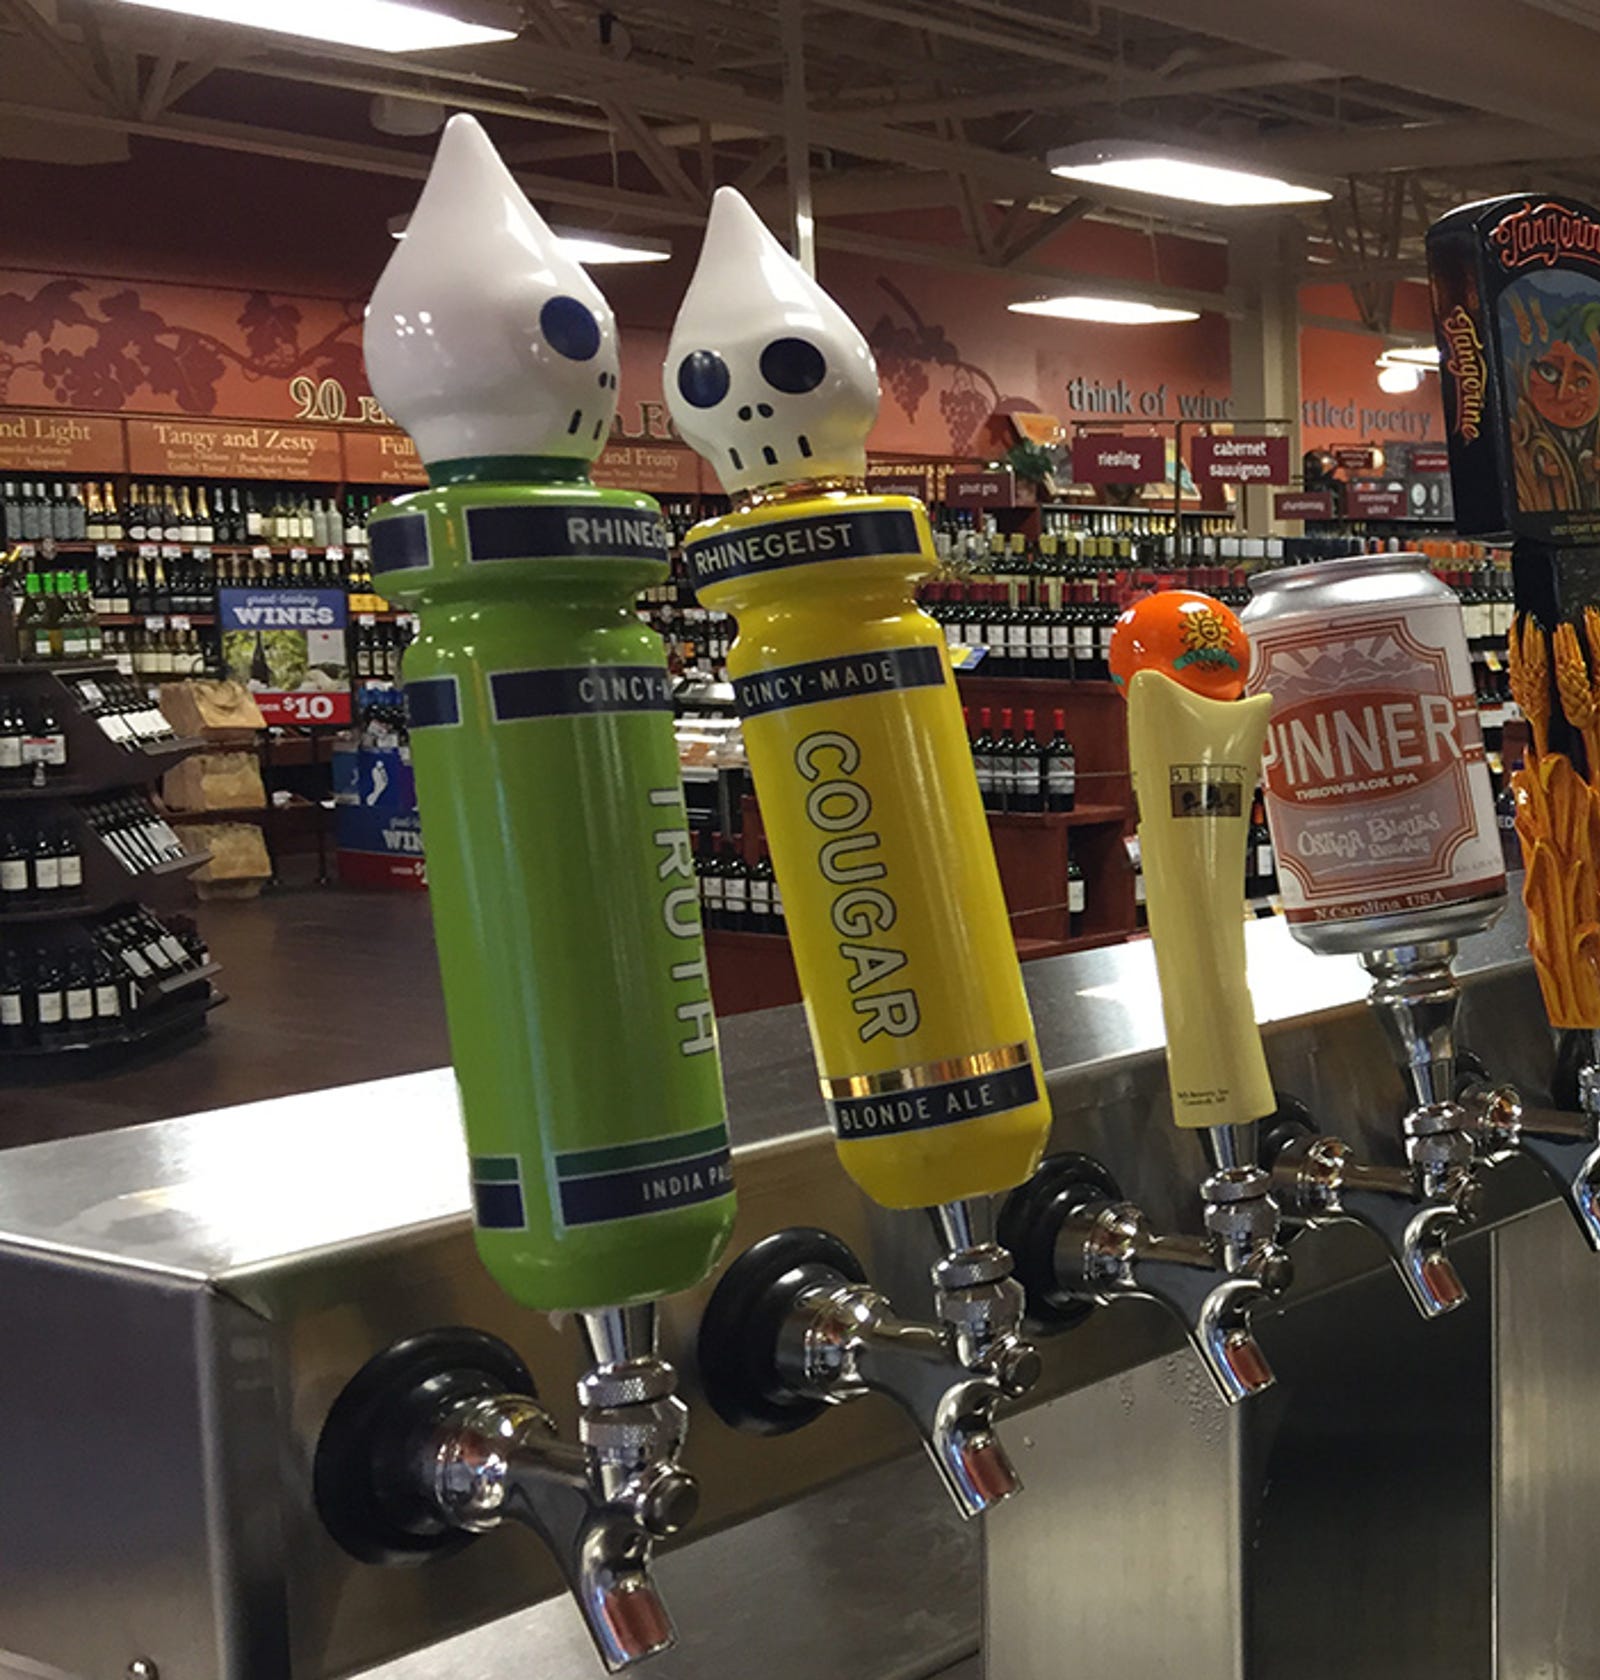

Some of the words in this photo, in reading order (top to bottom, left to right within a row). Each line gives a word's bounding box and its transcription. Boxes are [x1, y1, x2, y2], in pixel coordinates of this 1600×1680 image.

[1444, 304, 1485, 441] Tangerine
[1067, 376, 1133, 414] think
[1140, 384, 1168, 416] of
[0, 418, 26, 438] nd
[35, 419, 91, 446] Light
[1302, 398, 1357, 429] ttled
[1361, 407, 1432, 438] poetry
[153, 424, 216, 453] Tangy
[223, 429, 258, 448] and
[265, 430, 318, 457] Zesty
[380, 436, 415, 456] Full
[1213, 441, 1267, 457] cabernet
[604, 448, 631, 465] and
[1098, 450, 1141, 470] riesling
[1209, 462, 1271, 481] sauvignon
[568, 515, 669, 552] RHINEG
[695, 523, 853, 575] RHINEGEIST
[233, 607, 334, 626] WINES
[579, 676, 673, 703] CINCY-
[741, 659, 895, 708] CINCY-MADE
[282, 695, 334, 720] $10
[1263, 694, 1461, 785] PINNER
[795, 732, 919, 1044] COUGAR
[1407, 891, 1445, 907] USA
[840, 1095, 931, 1132] BLONDE
[946, 1084, 994, 1115] ALE
[642, 1172, 703, 1201] INDIA
